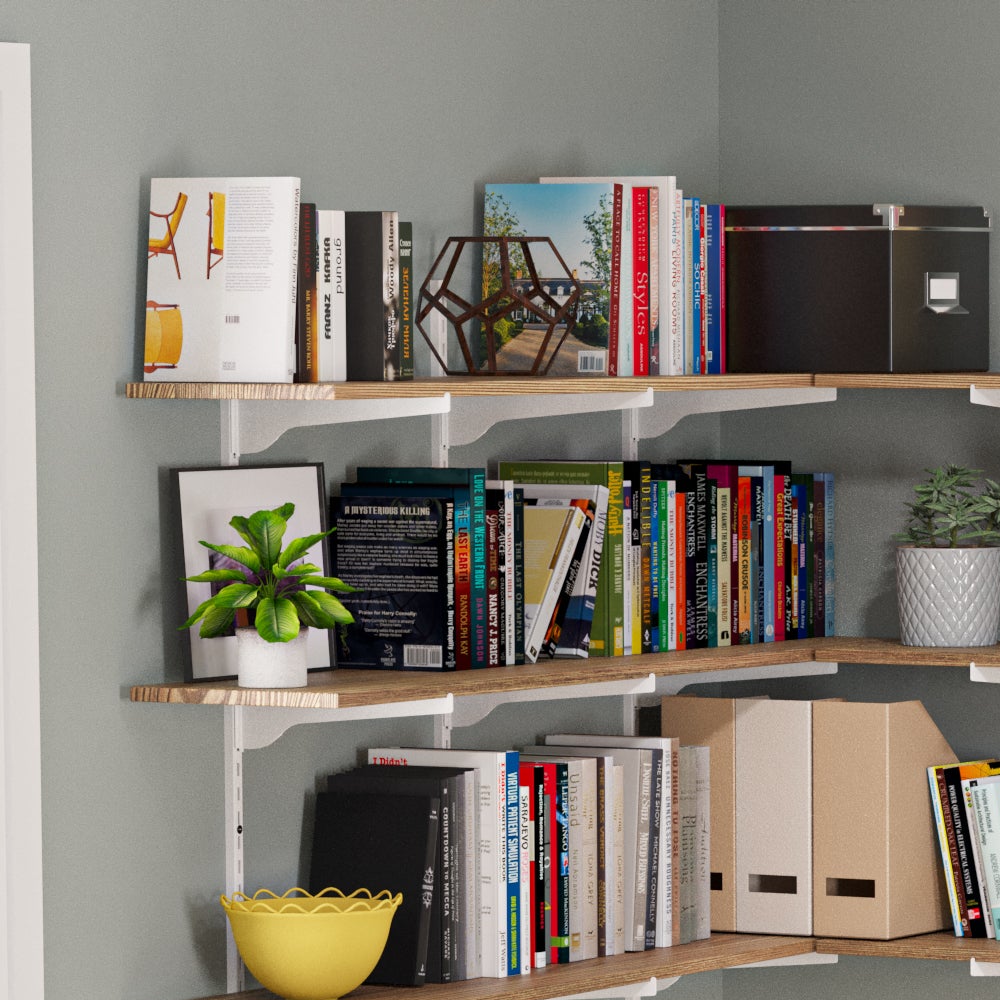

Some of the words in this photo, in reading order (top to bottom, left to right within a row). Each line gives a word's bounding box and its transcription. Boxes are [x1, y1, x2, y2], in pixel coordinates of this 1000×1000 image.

[323, 237, 331, 283] KAFKA
[334, 238, 344, 294] ground
[633, 272, 648, 336] Styles
[474, 474, 484, 493] LOVE
[695, 473, 705, 502] JAMES
[457, 502, 469, 524] THE
[474, 496, 484, 507] ON
[474, 510, 484, 523] THE
[641, 468, 651, 548] INDELIBLE
[458, 527, 468, 550] LAST
[687, 491, 695, 557] ENCHANTRESS
[697, 504, 705, 551] MAXWELL
[474, 526, 485, 562] WESTERN
[776, 517, 784, 567] Expectations
[459, 552, 469, 582] EARTH
[474, 564, 486, 590] FRONT
[642, 557, 650, 582] DAWN
[460, 594, 468, 638] RANDOLPH
[476, 597, 484, 620] DAWN
[489, 593, 497, 628] NANCY
[643, 585, 651, 625] METCALF
[696, 562, 708, 640] ENCHANTRESS
[460, 641, 468, 655] KAY
[476, 624, 484, 662] JOHNSON
[489, 638, 498, 665] PRICE
[507, 772, 518, 806] VIRTUAL
[569, 773, 580, 828] Unsaid
[507, 806, 519, 837] PATIENT
[561, 822, 569, 851] TANGO
[508, 838, 519, 883] SIMULATION
[651, 836, 659, 876] MICHAEL
[680, 815, 689, 884] Plainsong
[444, 870, 449, 881] TO
[649, 877, 657, 923] CONNELLY
